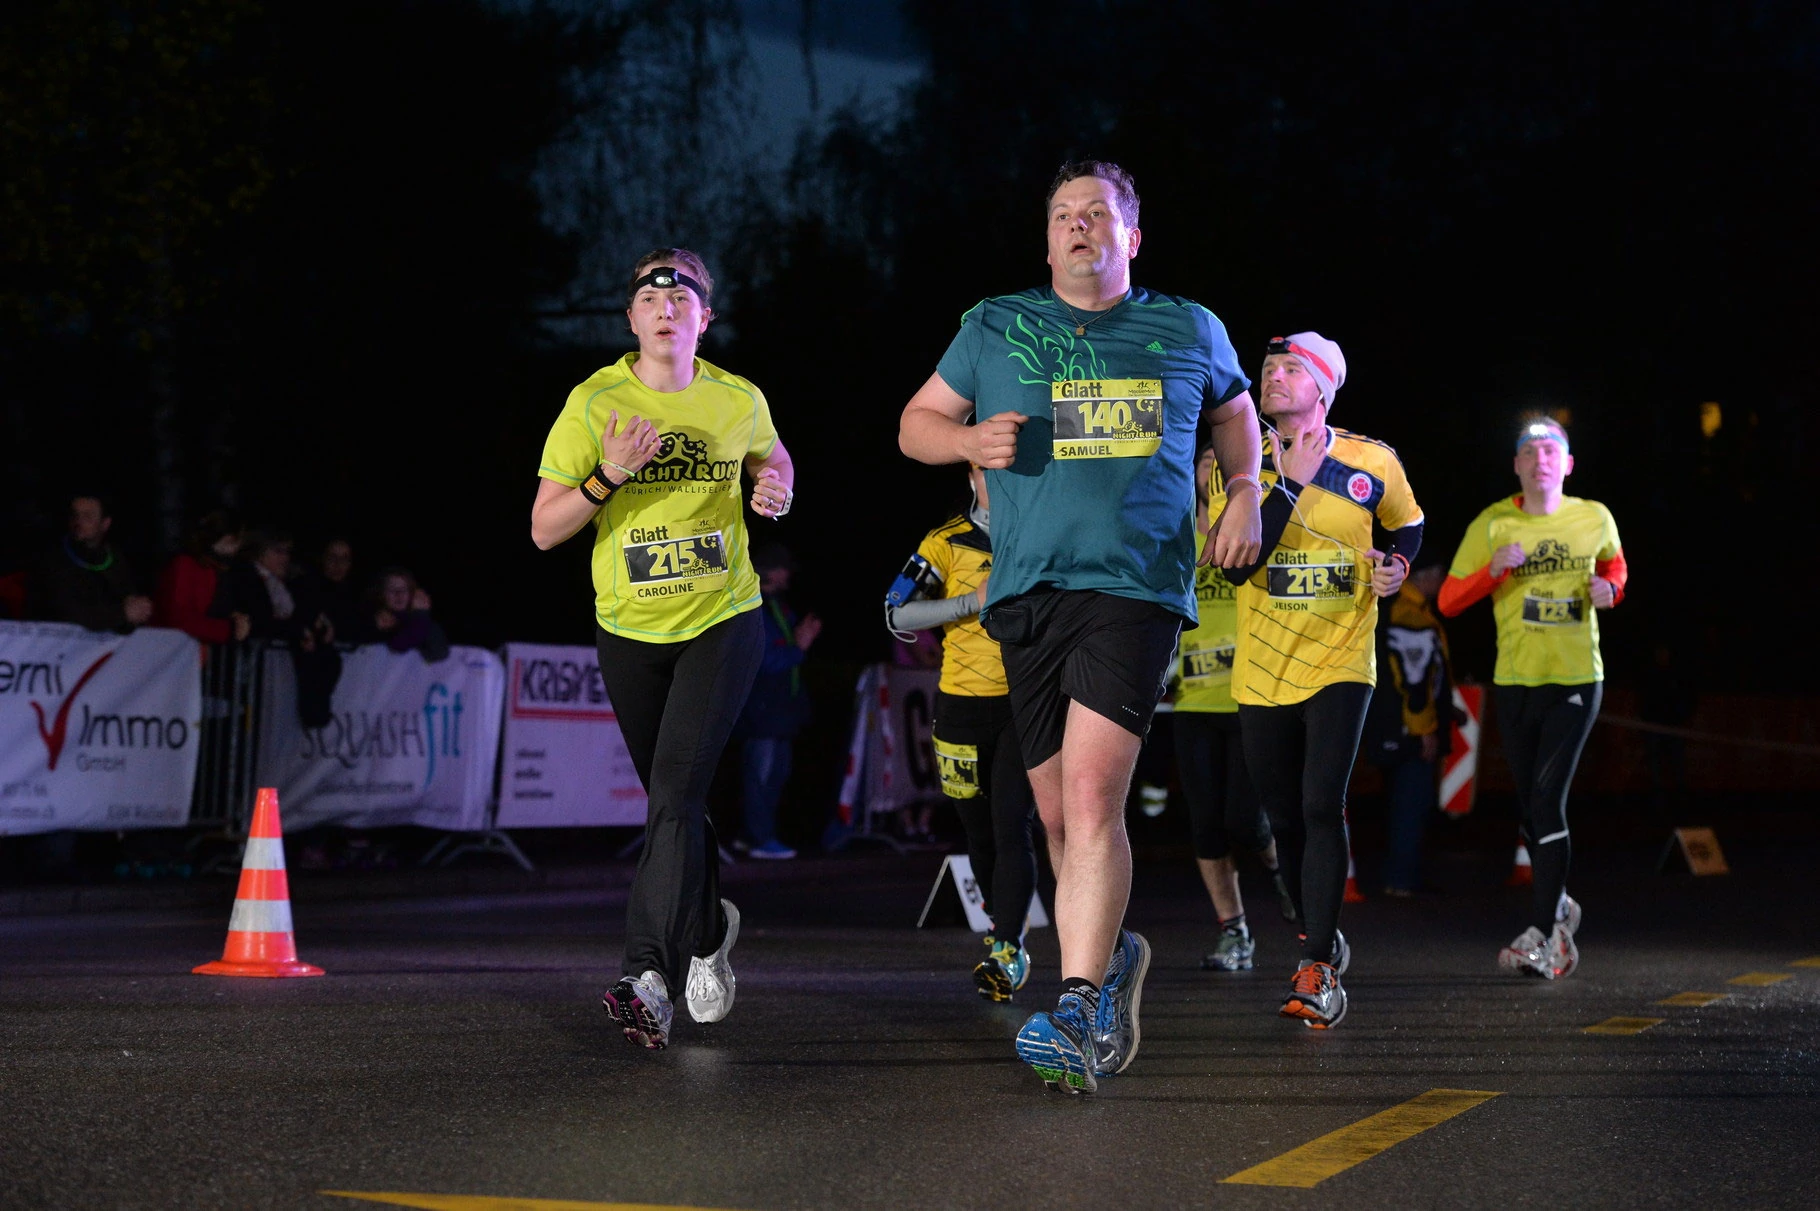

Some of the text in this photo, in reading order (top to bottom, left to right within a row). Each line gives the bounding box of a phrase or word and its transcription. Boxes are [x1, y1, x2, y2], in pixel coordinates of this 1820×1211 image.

[1061, 382, 1103, 398] Glatt
[1078, 401, 1132, 434] 140
[1139, 431, 1158, 439] RUN
[1061, 446, 1113, 457] SAMUEL
[629, 460, 738, 484] IGHT RUN
[630, 525, 669, 544] Glatt
[646, 540, 698, 576] 215
[1275, 552, 1308, 565] Glatt
[706, 565, 723, 574] RUN
[637, 582, 695, 598] CAROLINE
[1286, 567, 1330, 595] 213
[1274, 602, 1308, 611] JEISON
[1537, 601, 1570, 621] 123
[1189, 651, 1219, 676] 115
[79, 703, 189, 750] Immo
